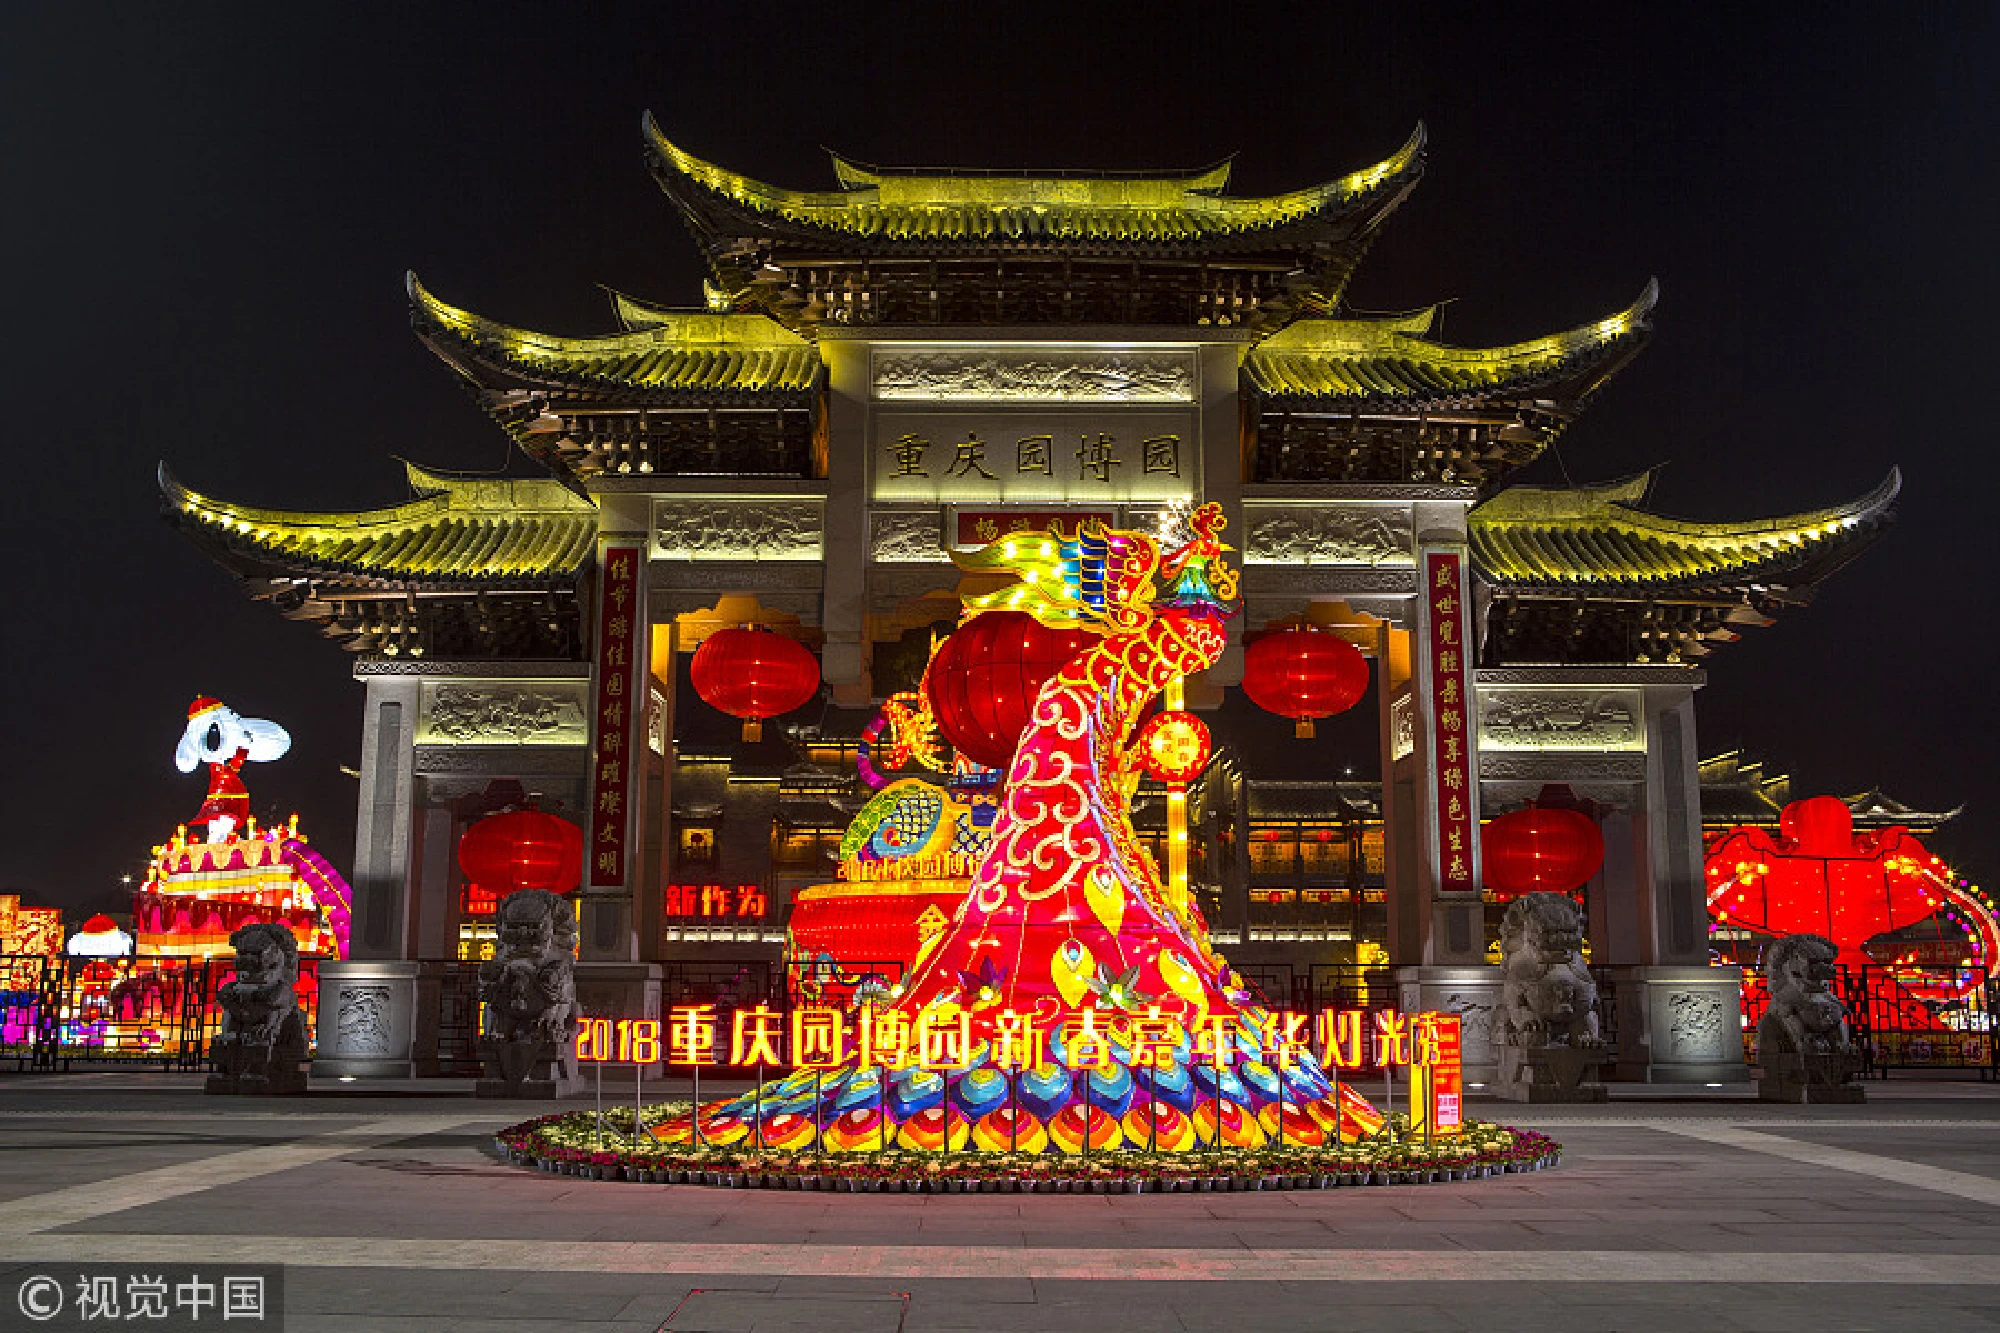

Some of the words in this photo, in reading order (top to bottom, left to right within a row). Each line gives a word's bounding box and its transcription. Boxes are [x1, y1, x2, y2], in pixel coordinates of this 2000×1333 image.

[887, 431, 1181, 482] 重庆园博园
